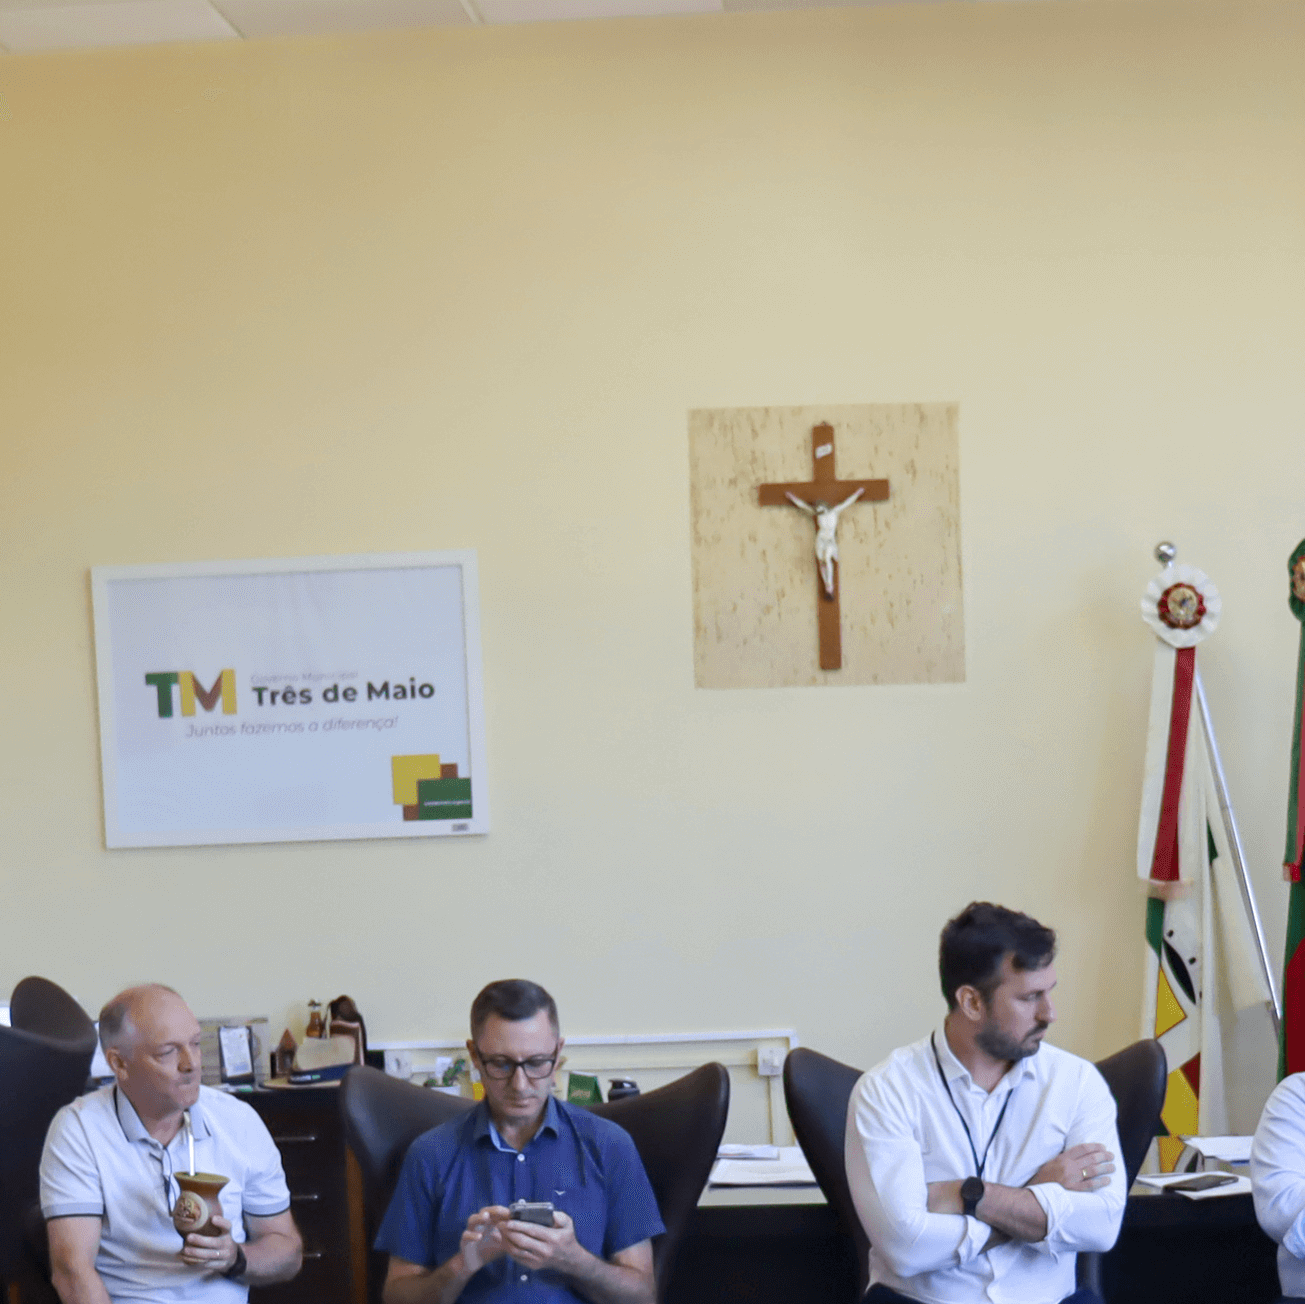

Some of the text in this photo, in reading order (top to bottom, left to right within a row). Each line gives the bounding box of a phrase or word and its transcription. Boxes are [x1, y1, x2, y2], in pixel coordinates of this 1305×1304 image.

[145, 668, 237, 719] TM
[252, 676, 435, 707] Três de Maio
[186, 716, 399, 738] Juntos fazemos a diferença!
